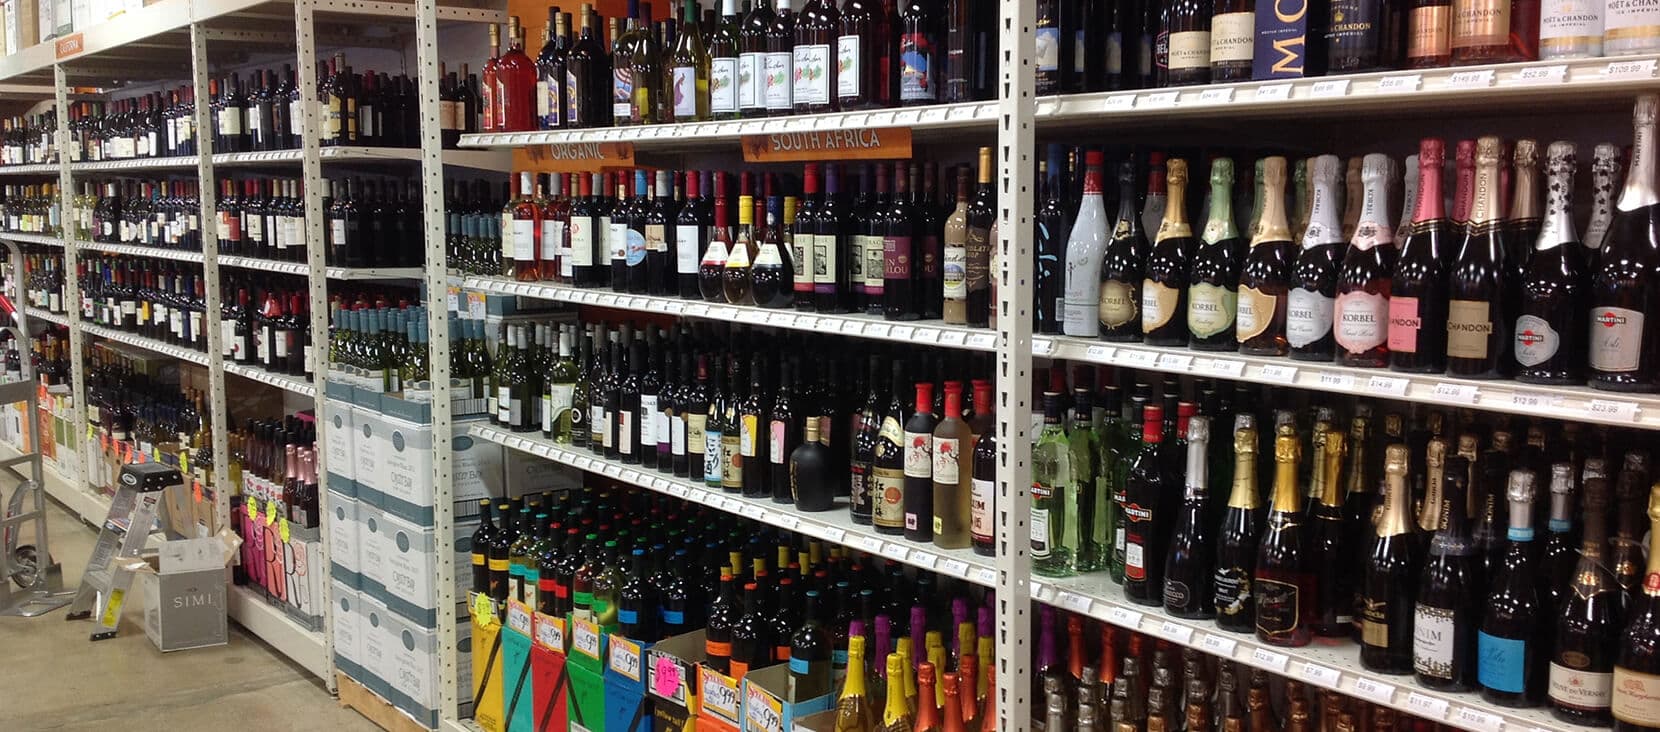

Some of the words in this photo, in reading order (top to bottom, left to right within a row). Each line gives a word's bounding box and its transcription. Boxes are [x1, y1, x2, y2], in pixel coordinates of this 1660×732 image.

[1562, 14, 1599, 23] CHANDON
[1220, 36, 1254, 46] CHANDON
[771, 131, 820, 151] SOUTH
[825, 128, 881, 149] AFRICA
[551, 142, 605, 160] ORGANIC
[1413, 173, 1425, 218] CHANDON
[1458, 173, 1470, 216] CHANDON
[1475, 172, 1487, 218] CHANDON
[1191, 302, 1220, 312] KORBEL
[1342, 313, 1377, 322] KORBEL
[1597, 316, 1626, 324] MARTINI
[1447, 322, 1491, 332] CHANDON
[174, 593, 213, 609] SIMI
